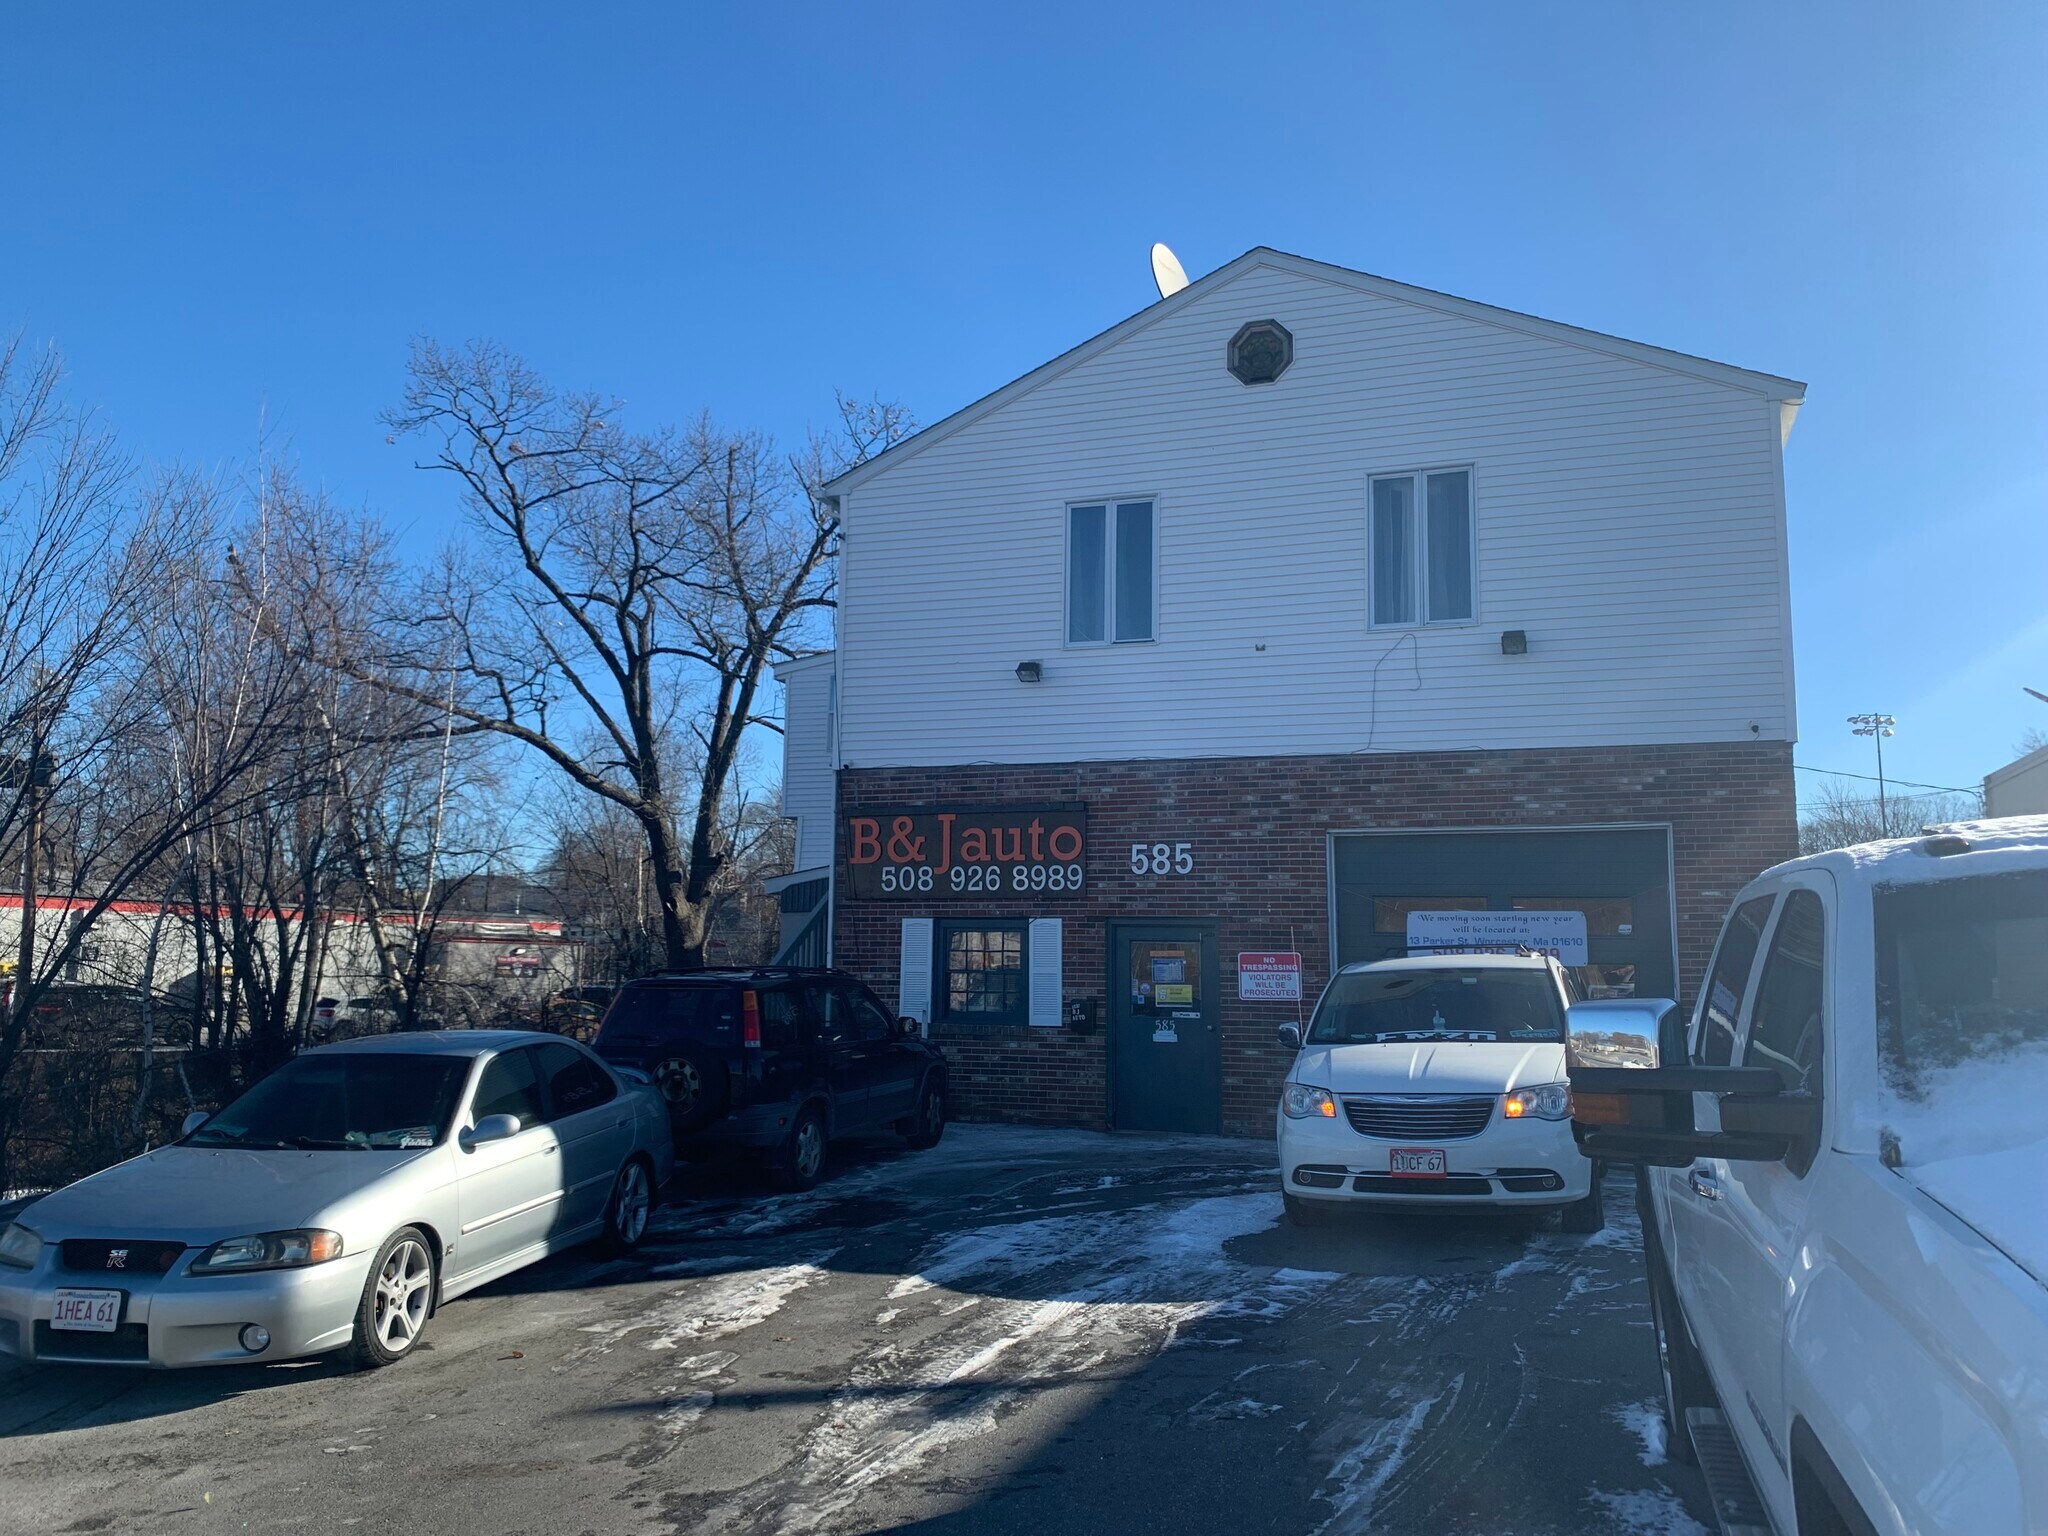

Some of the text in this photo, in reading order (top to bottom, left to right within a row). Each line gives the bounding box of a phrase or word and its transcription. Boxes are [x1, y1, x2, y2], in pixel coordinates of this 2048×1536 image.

[1130, 843, 1194, 875] 585
[881, 864, 1083, 892] 508 926 8989
[1418, 914, 1434, 922] We
[1437, 914, 1468, 924] moving
[1494, 914, 1528, 924] starting
[1553, 915, 1573, 925] year
[1452, 925, 1469, 933] will
[1473, 925, 1483, 933] be
[1485, 925, 1516, 933] located
[1409, 936, 1420, 945] 13
[1423, 936, 1455, 945] Parker
[1533, 937, 1550, 946] Ma
[1552, 937, 1583, 946] 01610
[1155, 1020, 1175, 1031] 585
[1428, 1157, 1442, 1170] 67
[55, 1300, 114, 1322] 1HEA 61
